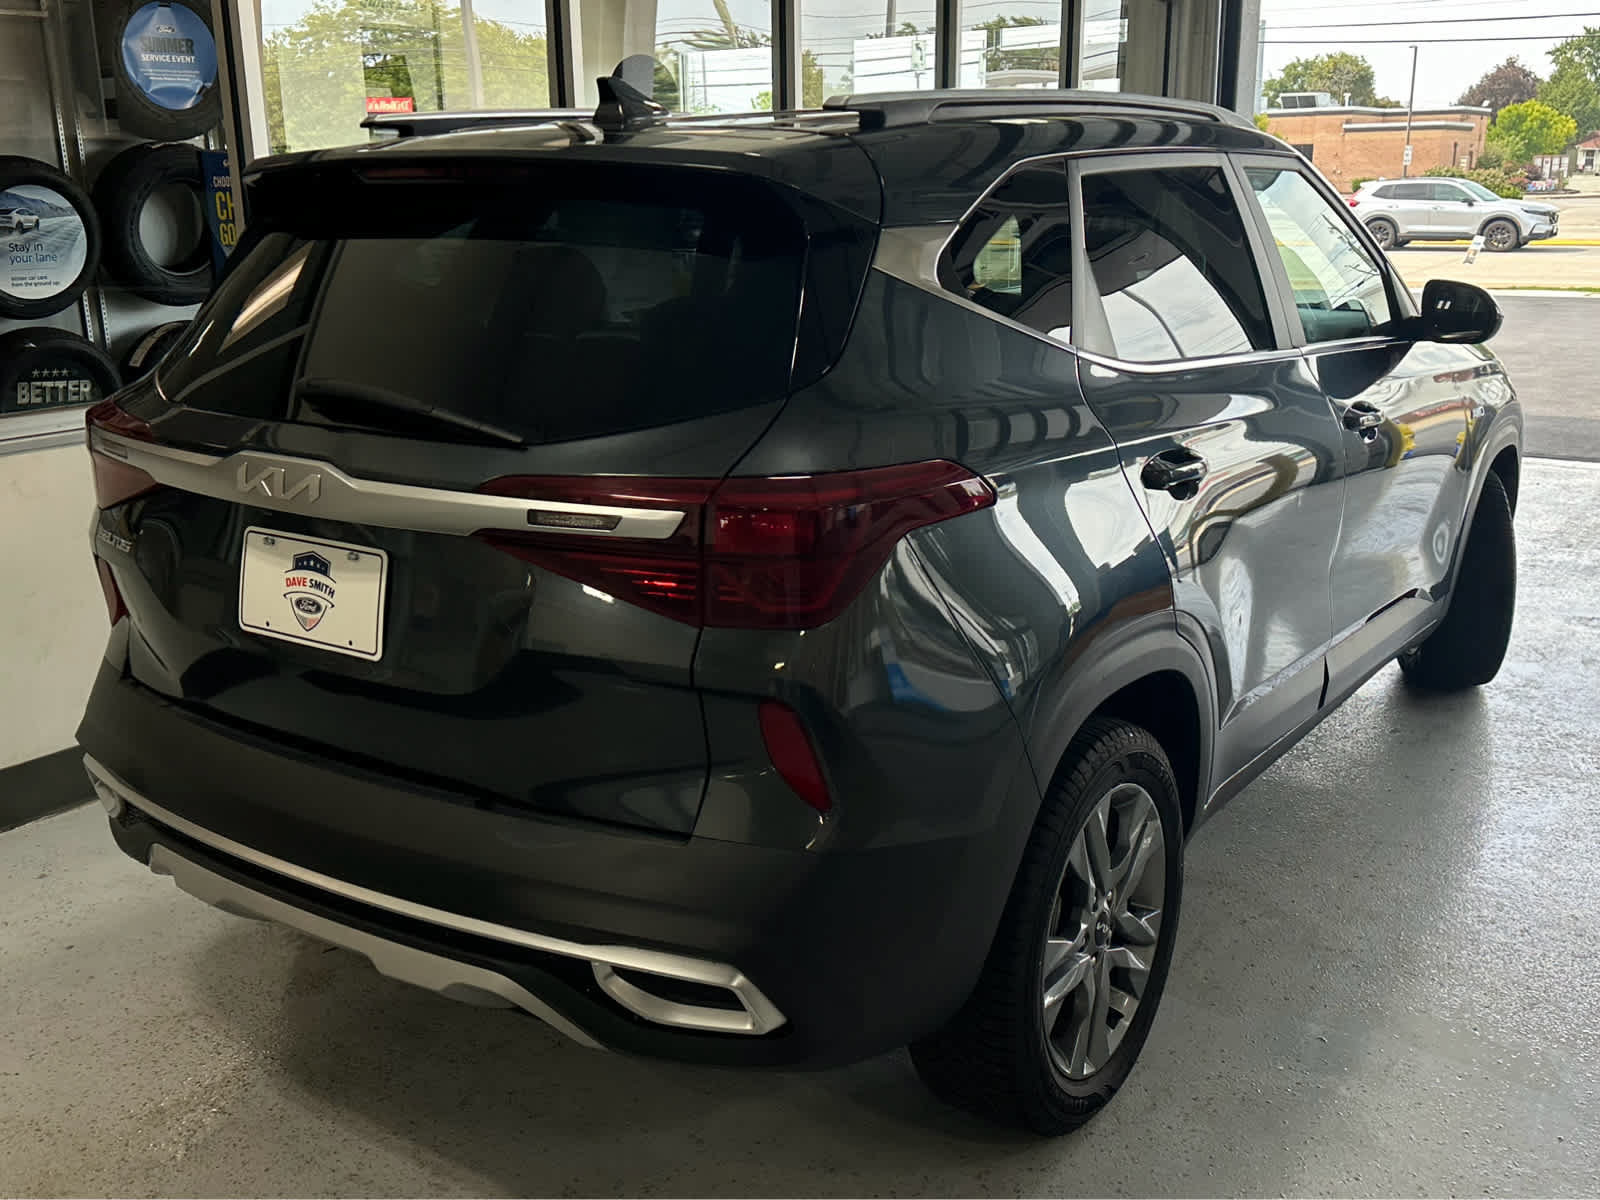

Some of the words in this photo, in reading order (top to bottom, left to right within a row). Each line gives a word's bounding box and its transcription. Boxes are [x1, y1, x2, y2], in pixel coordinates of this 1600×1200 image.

[142, 37, 195, 54] SUMMER
[141, 54, 170, 63] SERVICE
[171, 55, 195, 64] EVENT
[8, 242, 31, 254] Stay
[34, 242, 44, 252] in
[9, 254, 33, 265] your
[35, 252, 58, 262] lane
[17, 379, 93, 405] BETTER
[285, 576, 308, 588] DAVE
[308, 578, 336, 599] SMITH
